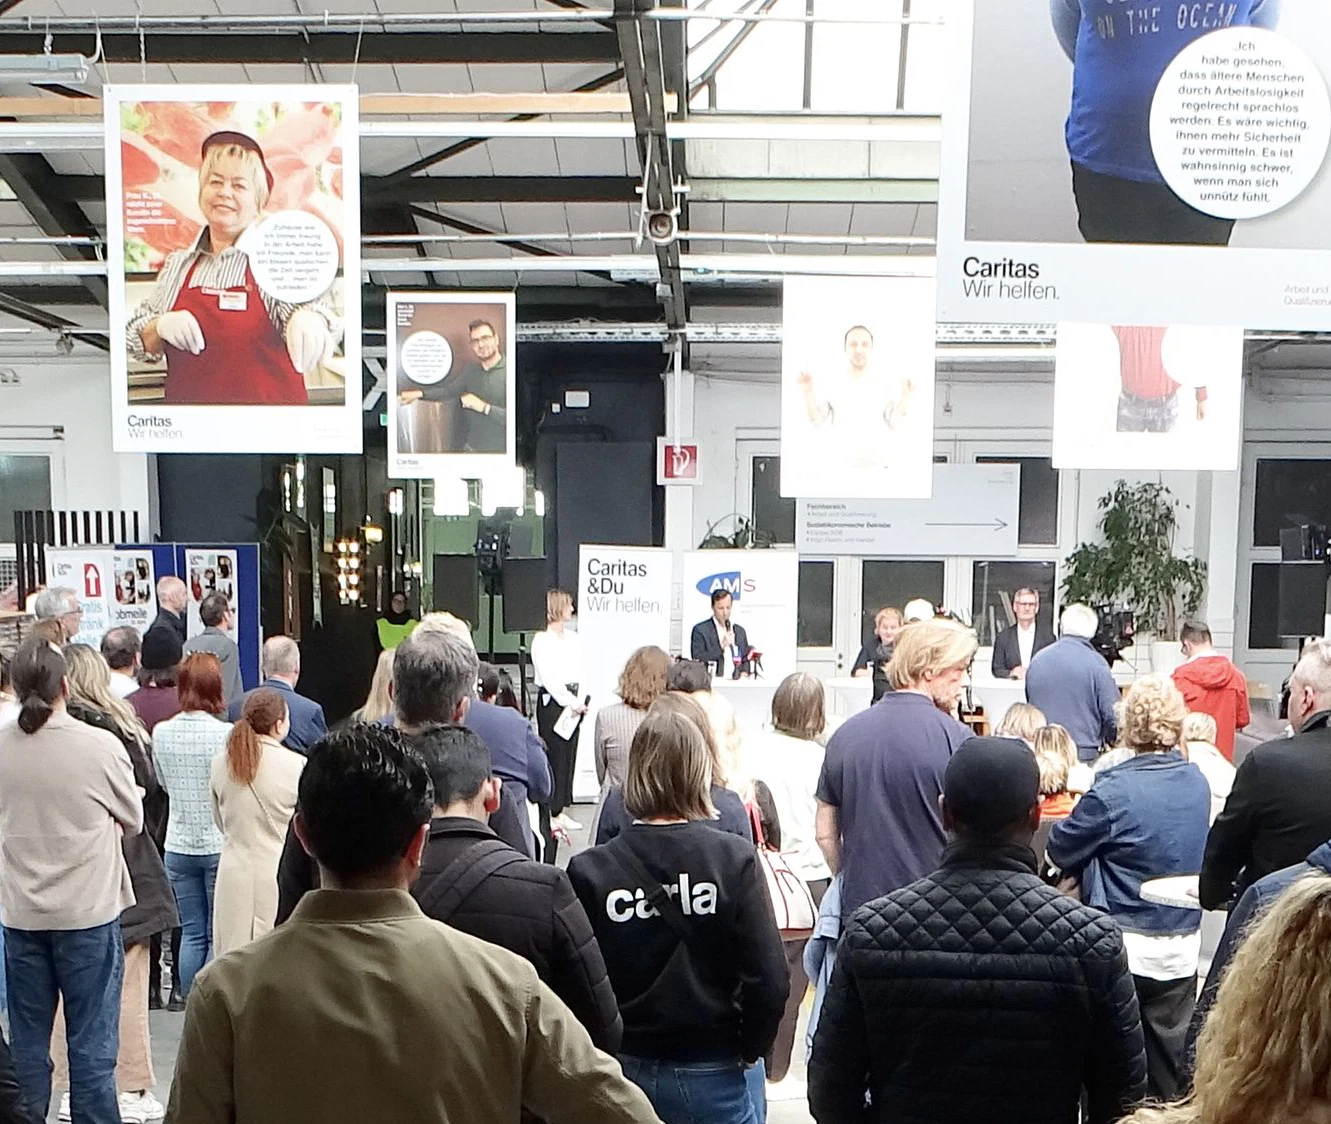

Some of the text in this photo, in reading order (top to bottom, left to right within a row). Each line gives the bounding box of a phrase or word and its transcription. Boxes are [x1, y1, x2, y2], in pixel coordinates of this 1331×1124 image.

[1126, 7, 1161, 35] THE
[1177, 3, 1238, 30] OCEAN
[1201, 56, 1230, 65] habe
[1179, 70, 1304, 82] dass ältere Menschen
[1178, 84, 1304, 100] durch Arbeitslosigkeit
[1181, 100, 1299, 113] regelrecht sprachlos
[1169, 115, 1214, 126] werden.
[1218, 116, 1231, 126] Es
[1235, 117, 1262, 127] wäre
[1175, 130, 1301, 143] ihnen mehr Sicherheit
[1182, 146, 1294, 158] zu vermitteln. Es ist
[1181, 160, 1247, 173] wahnsinnig
[1194, 177, 1224, 186] wenn
[1255, 177, 1279, 188] sich
[1200, 190, 1239, 202] unnütz
[963, 256, 1040, 279] Caritas
[963, 279, 1060, 300] Wir helfen.
[127, 414, 173, 428] Caritas
[587, 558, 647, 577] Caritas
[587, 577, 624, 595] &Du
[709, 576, 757, 594] AMS
[587, 596, 663, 614] Wir helfen.
